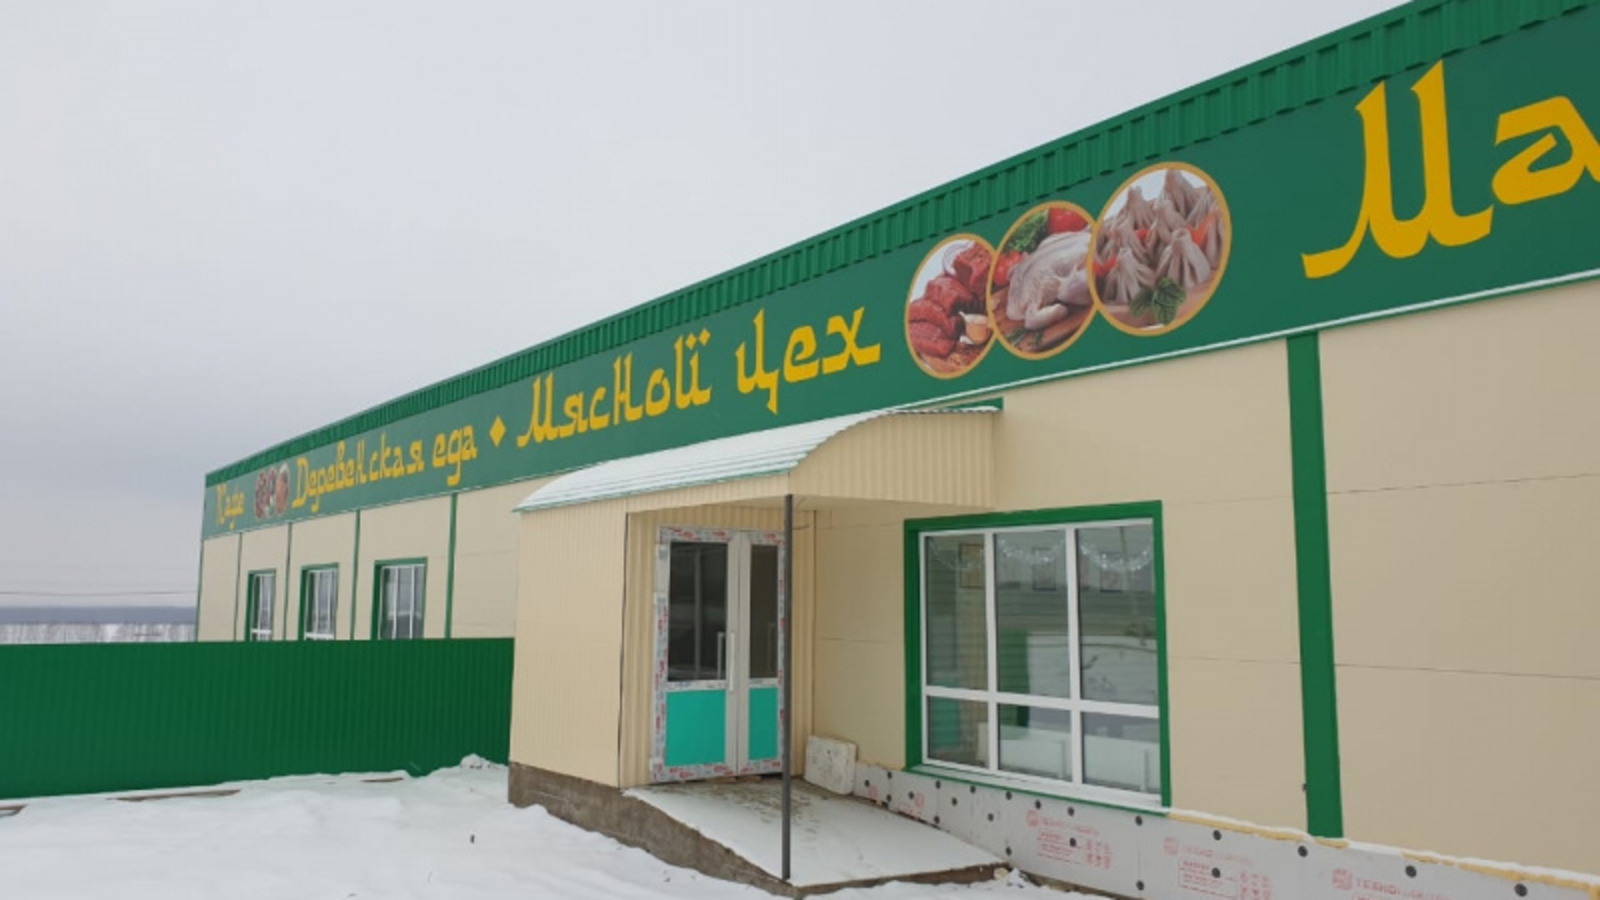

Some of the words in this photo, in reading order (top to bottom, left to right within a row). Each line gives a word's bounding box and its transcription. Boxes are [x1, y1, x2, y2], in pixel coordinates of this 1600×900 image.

[292, 433, 425, 514] Деревенская
[432, 425, 478, 486] еда
[516, 328, 712, 448] Мясной
[735, 306, 881, 415] цех
[1302, 59, 1600, 279] Ма
